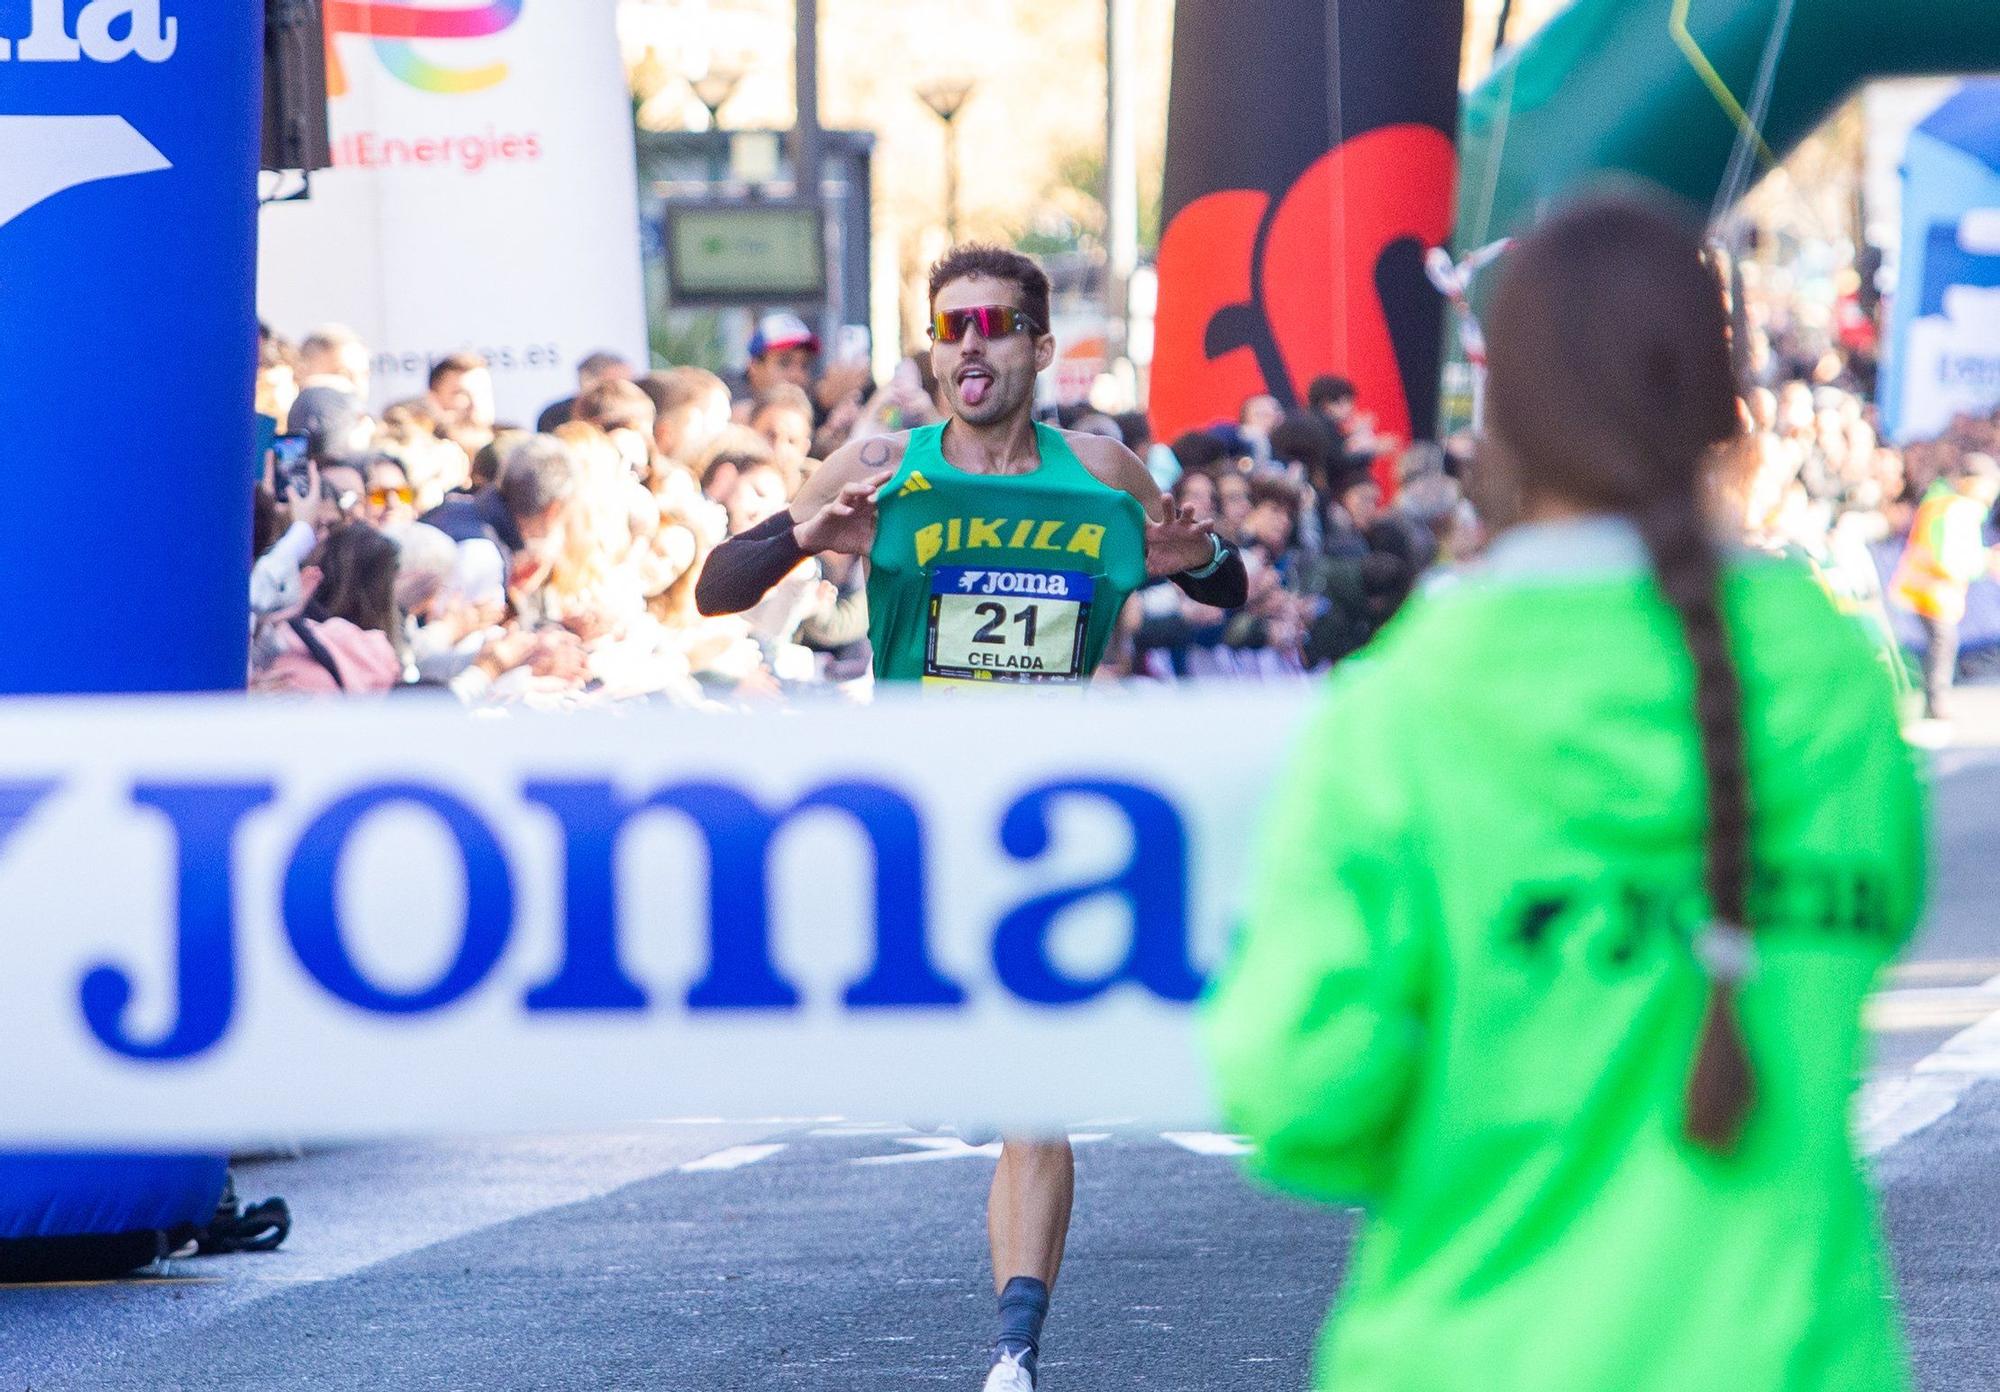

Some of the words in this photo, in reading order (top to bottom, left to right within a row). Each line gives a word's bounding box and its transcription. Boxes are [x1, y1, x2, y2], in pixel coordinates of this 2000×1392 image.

[914, 518, 1106, 567] BIKILA
[971, 601, 1038, 646] 21
[968, 651, 1044, 670] CELADA
